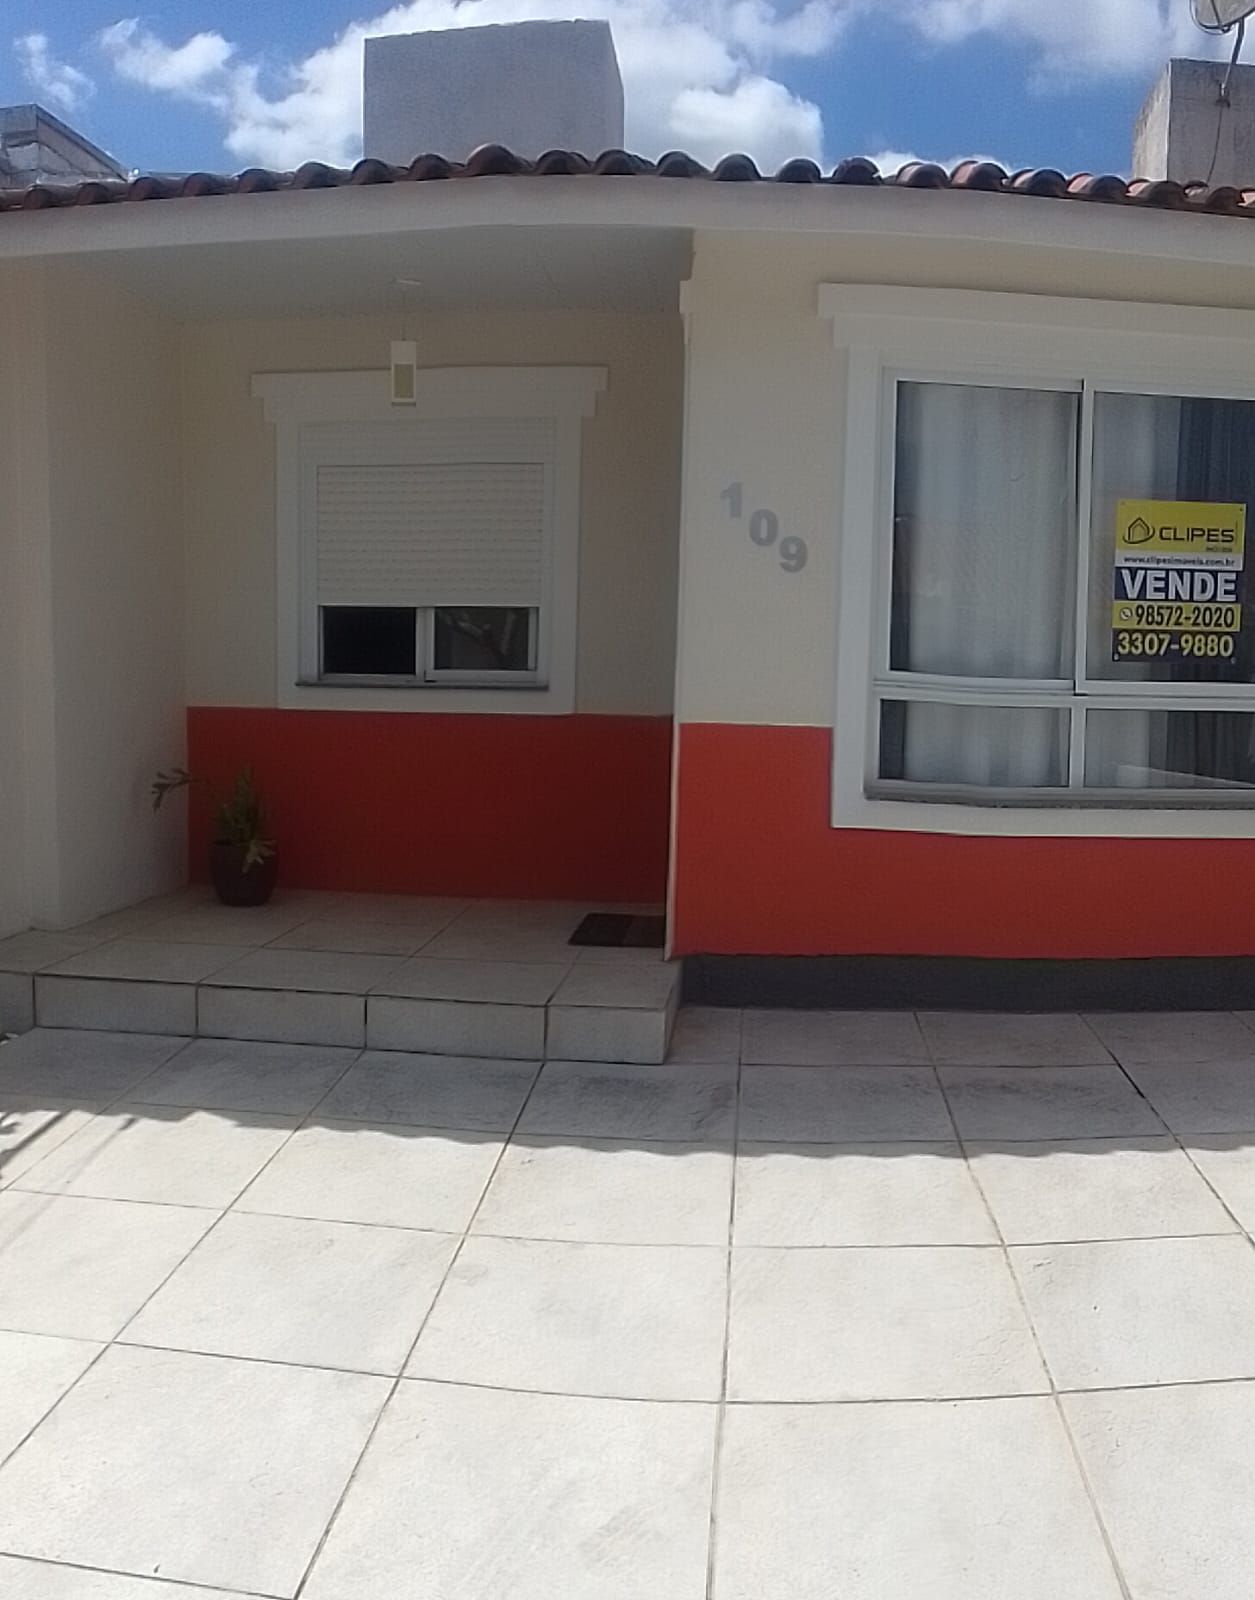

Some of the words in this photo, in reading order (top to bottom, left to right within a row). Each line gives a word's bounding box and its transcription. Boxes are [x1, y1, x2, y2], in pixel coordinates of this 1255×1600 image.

[720, 481, 808, 573] 109
[1159, 527, 1235, 543] CLIPES
[1120, 569, 1237, 602] VENDE
[1135, 604, 1235, 628] 98572-2020
[1118, 631, 1234, 657] 3307-9880
